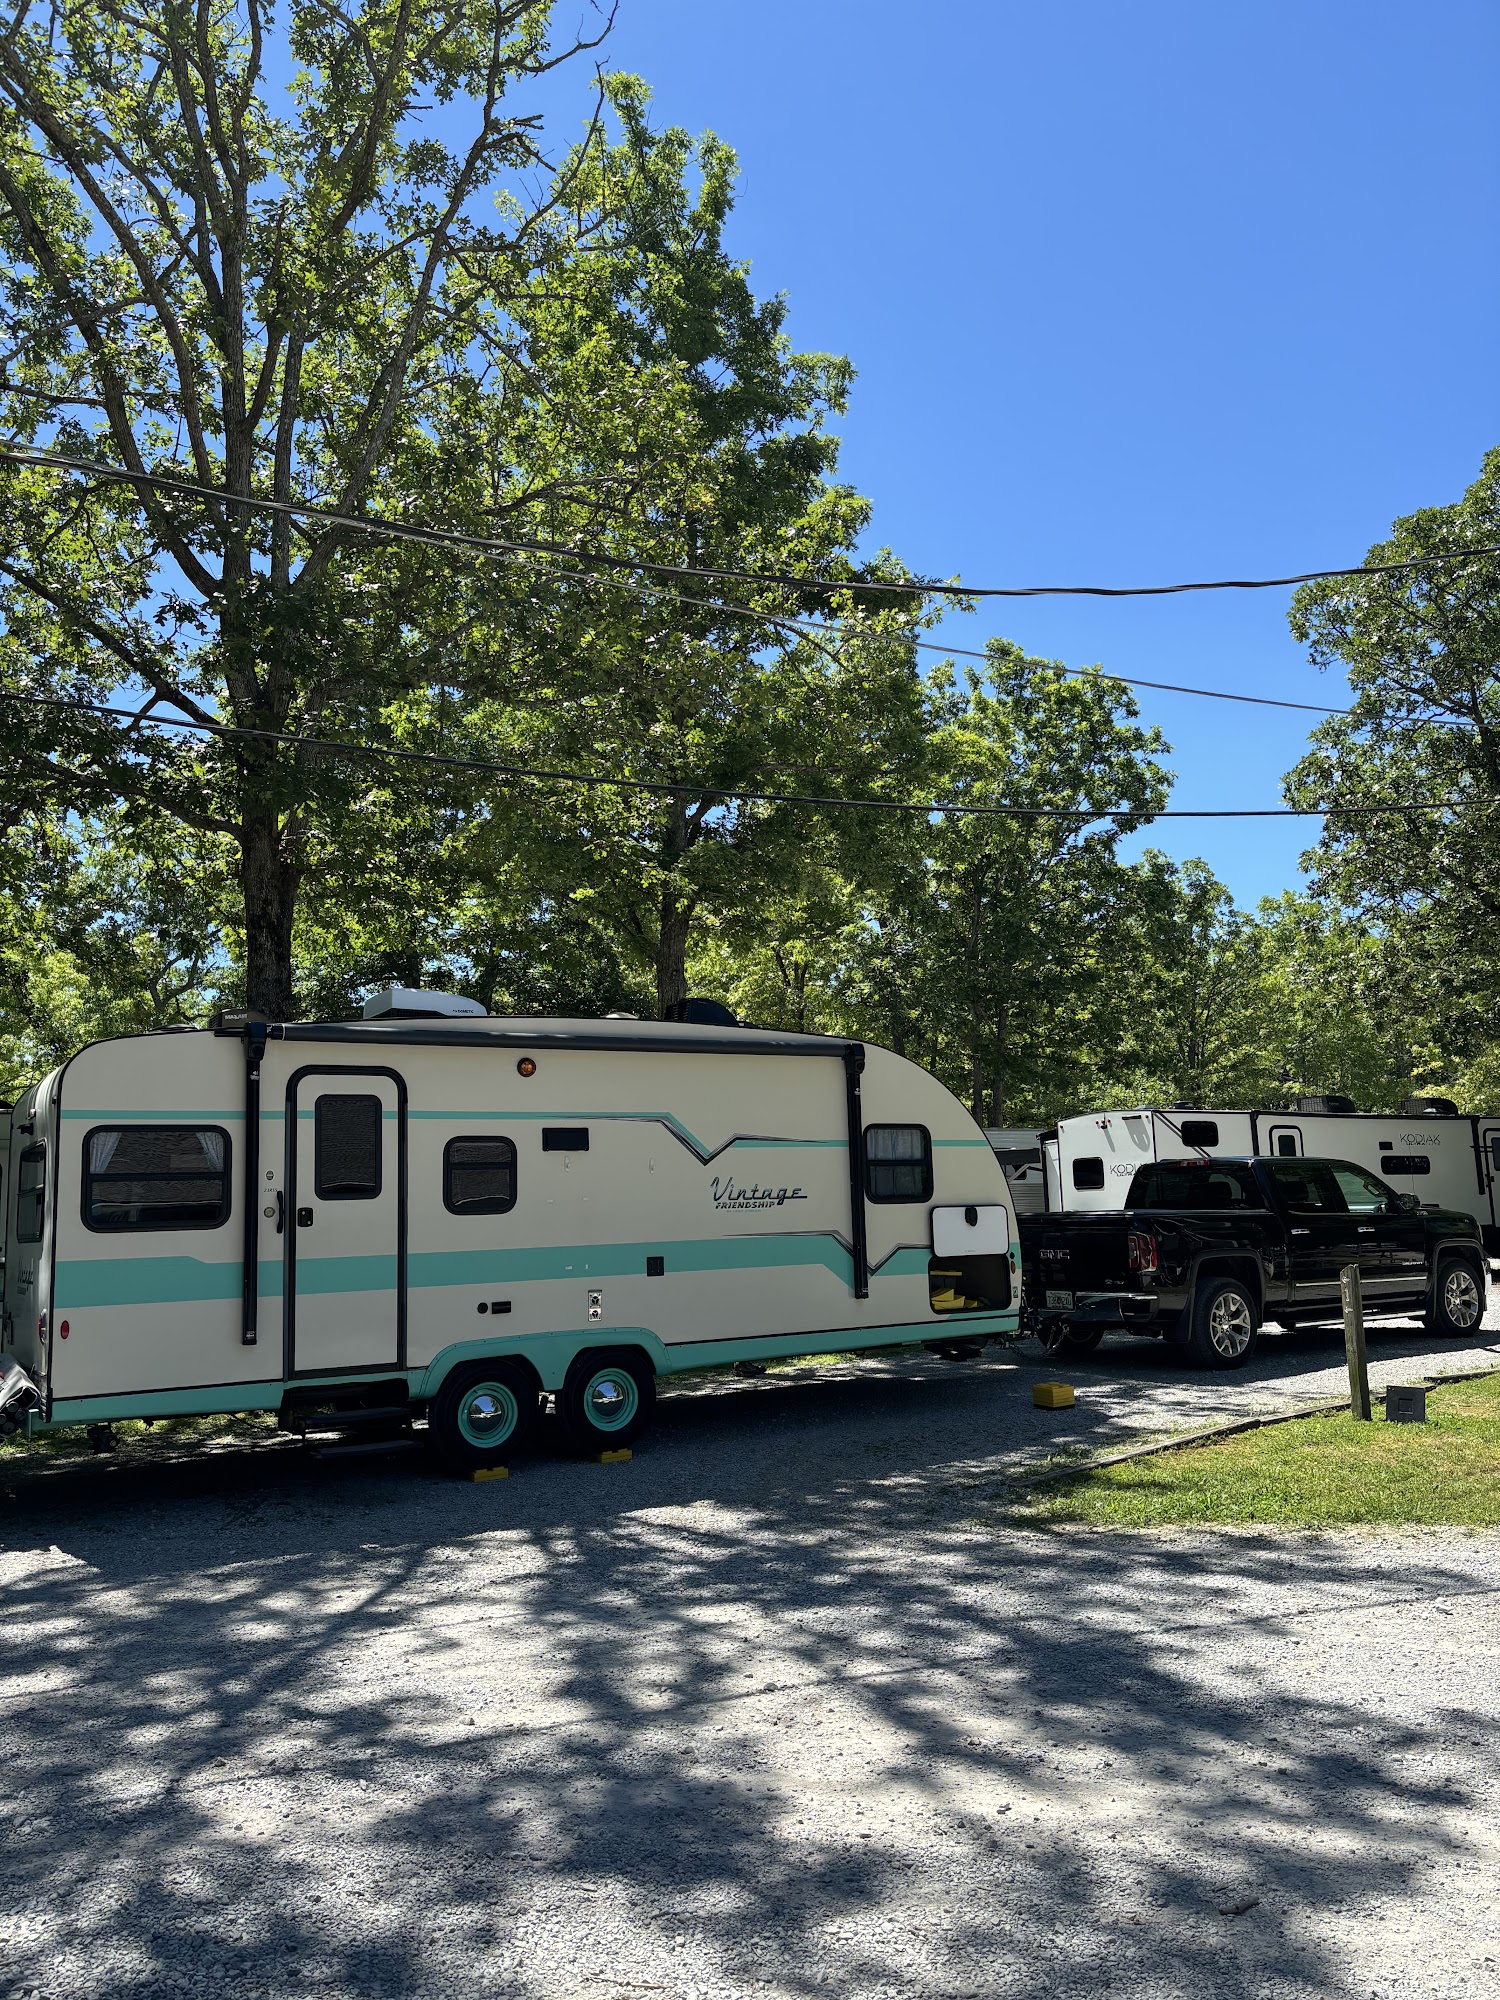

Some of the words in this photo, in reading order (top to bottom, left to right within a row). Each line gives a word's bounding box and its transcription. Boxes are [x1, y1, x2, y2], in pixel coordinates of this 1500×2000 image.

[1399, 1133, 1441, 1144] KODIAK
[1109, 1163, 1138, 1175] KODI
[710, 1176, 808, 1206] Vintage
[715, 1201, 775, 1210] FRIENDSHIP
[1039, 1249, 1070, 1260] GMC
